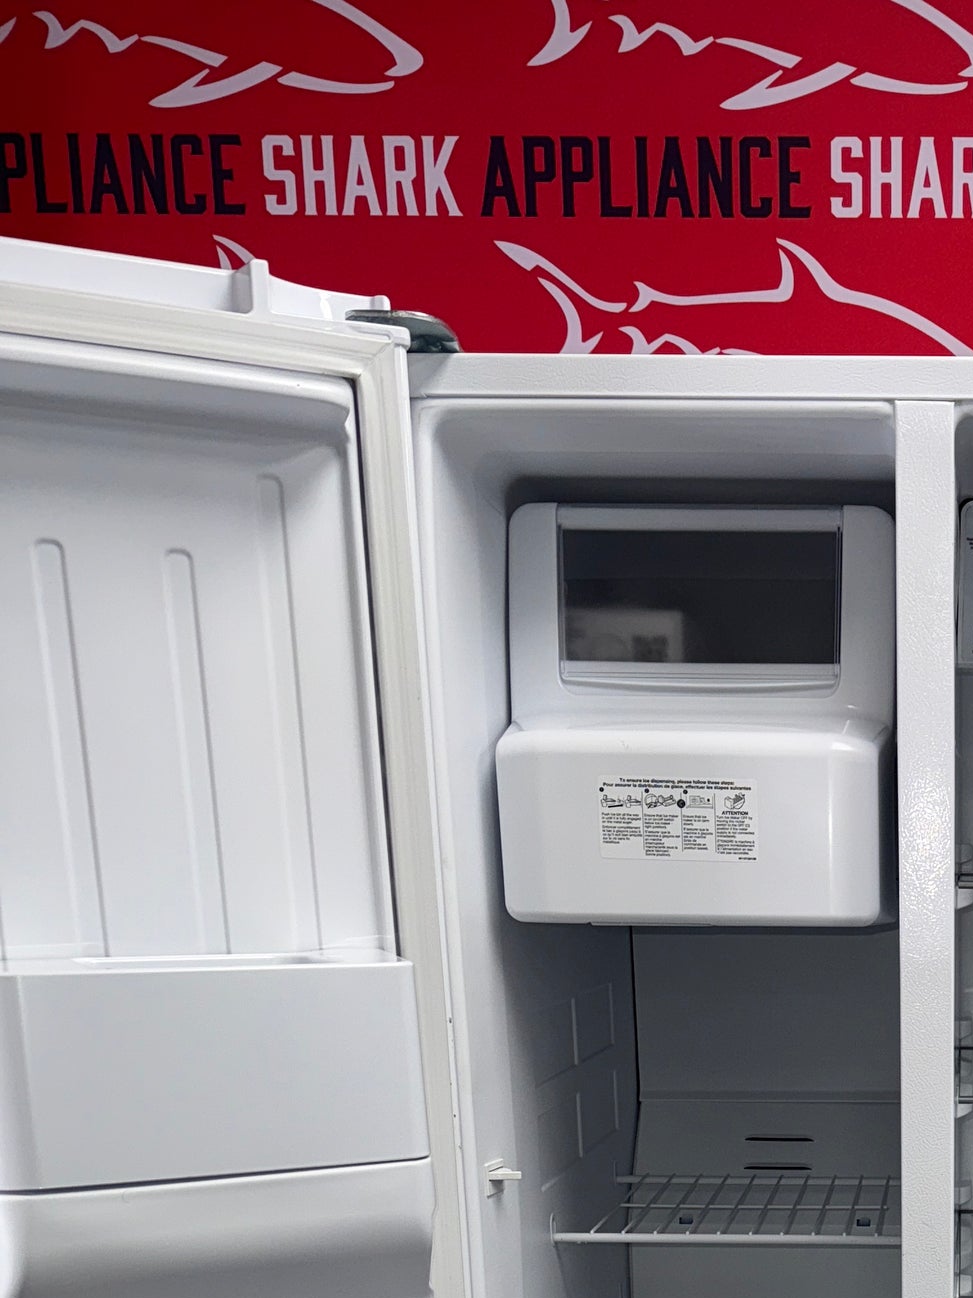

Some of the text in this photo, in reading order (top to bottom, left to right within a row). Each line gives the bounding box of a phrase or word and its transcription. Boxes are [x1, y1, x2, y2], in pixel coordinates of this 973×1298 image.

[0, 132, 246, 215] PLIANCE
[261, 133, 463, 217] SHARK
[481, 134, 811, 219] APPLIANCE
